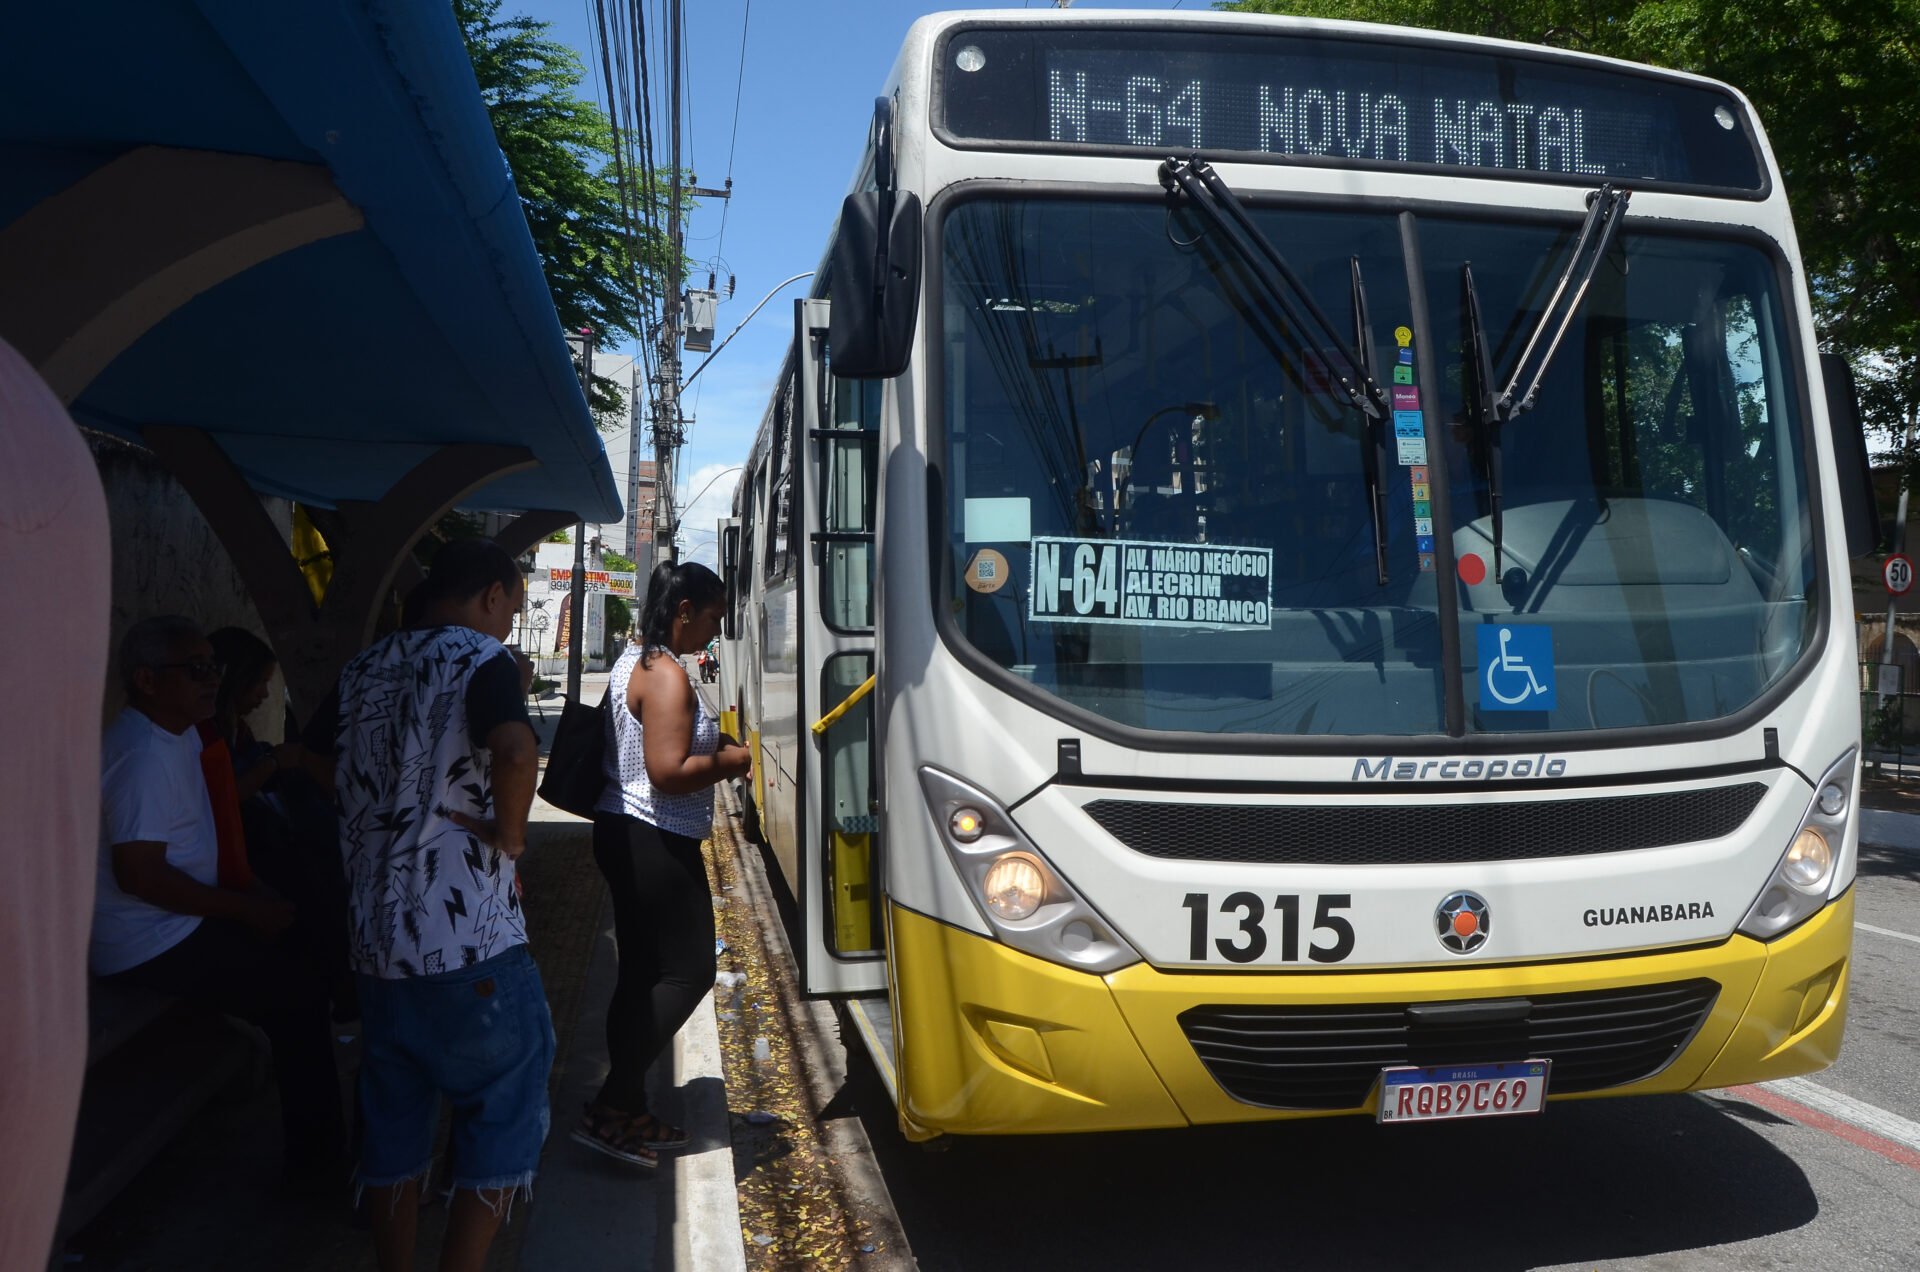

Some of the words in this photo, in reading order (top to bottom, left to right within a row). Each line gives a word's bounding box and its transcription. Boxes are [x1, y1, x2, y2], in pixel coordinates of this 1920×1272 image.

[1050, 70, 1201, 149] N-64
[1259, 85, 1407, 162] NOVA
[1434, 97, 1606, 174] NATAL
[550, 568, 610, 583] EMPSTIMO
[1126, 548, 1149, 571] AV.
[1152, 546, 1200, 573] MÁRIO
[1203, 550, 1267, 577] NEGÓCIO
[1890, 563, 1908, 582] 50
[1036, 543, 1118, 615] N-64
[1126, 571, 1221, 597] ALECRIM
[1125, 595, 1153, 618] AV.
[1157, 596, 1189, 620] RIO
[1193, 598, 1267, 624] BRANCO
[1352, 753, 1567, 782] Marcopolo
[1181, 891, 1356, 963] 1315
[1582, 901, 1715, 928] GUANABARA
[1452, 1071, 1478, 1080] BRASIL
[1397, 1079, 1528, 1116] RQB9C69
